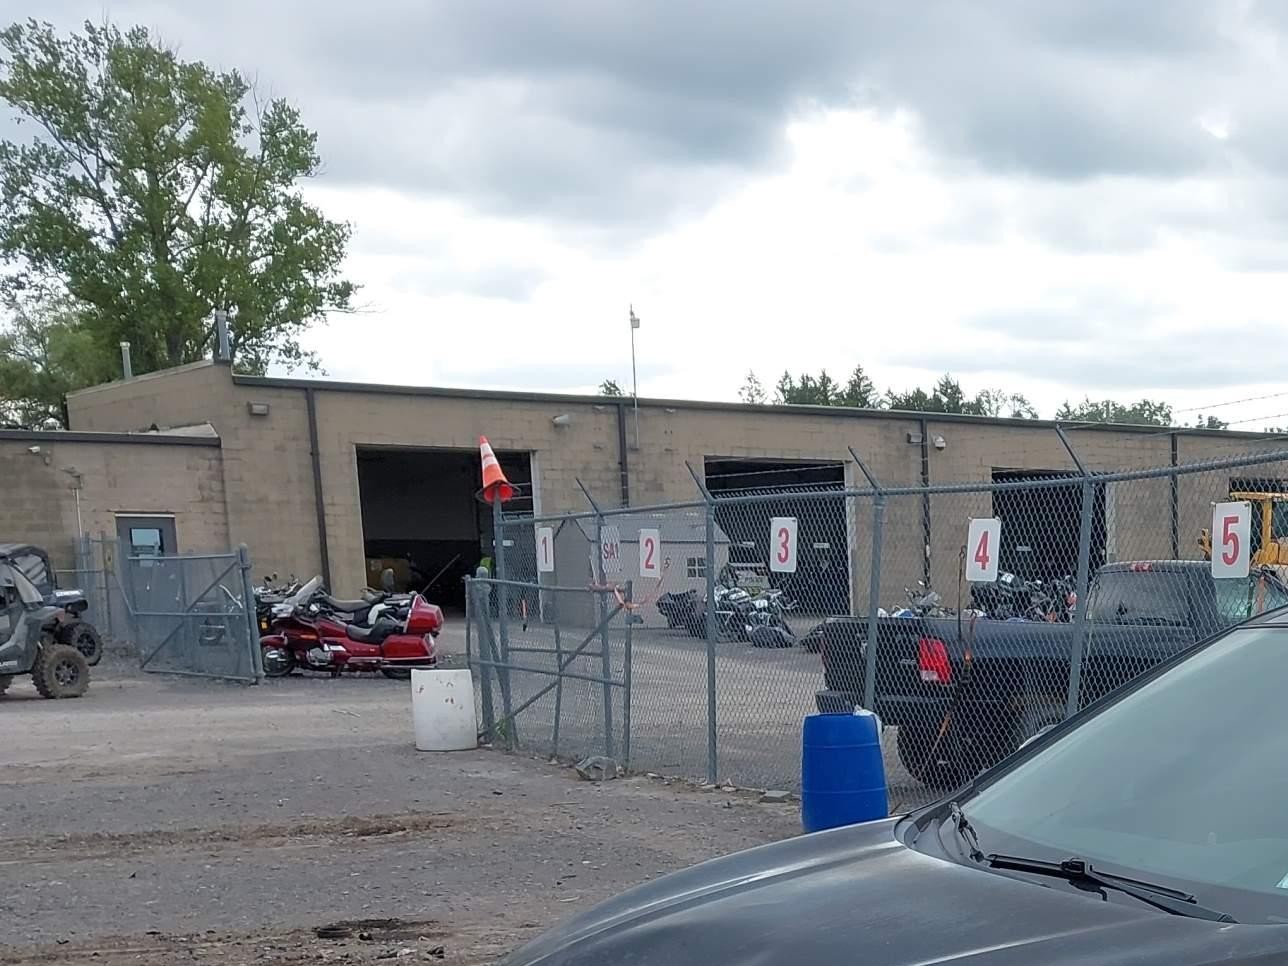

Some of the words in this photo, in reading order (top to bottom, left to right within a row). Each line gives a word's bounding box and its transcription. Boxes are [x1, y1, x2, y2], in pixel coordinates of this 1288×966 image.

[541, 536, 548, 564] 1
[645, 538, 655, 570] 2
[777, 528, 789, 563] 3
[974, 531, 990, 570] 4
[1221, 516, 1239, 566] 5
